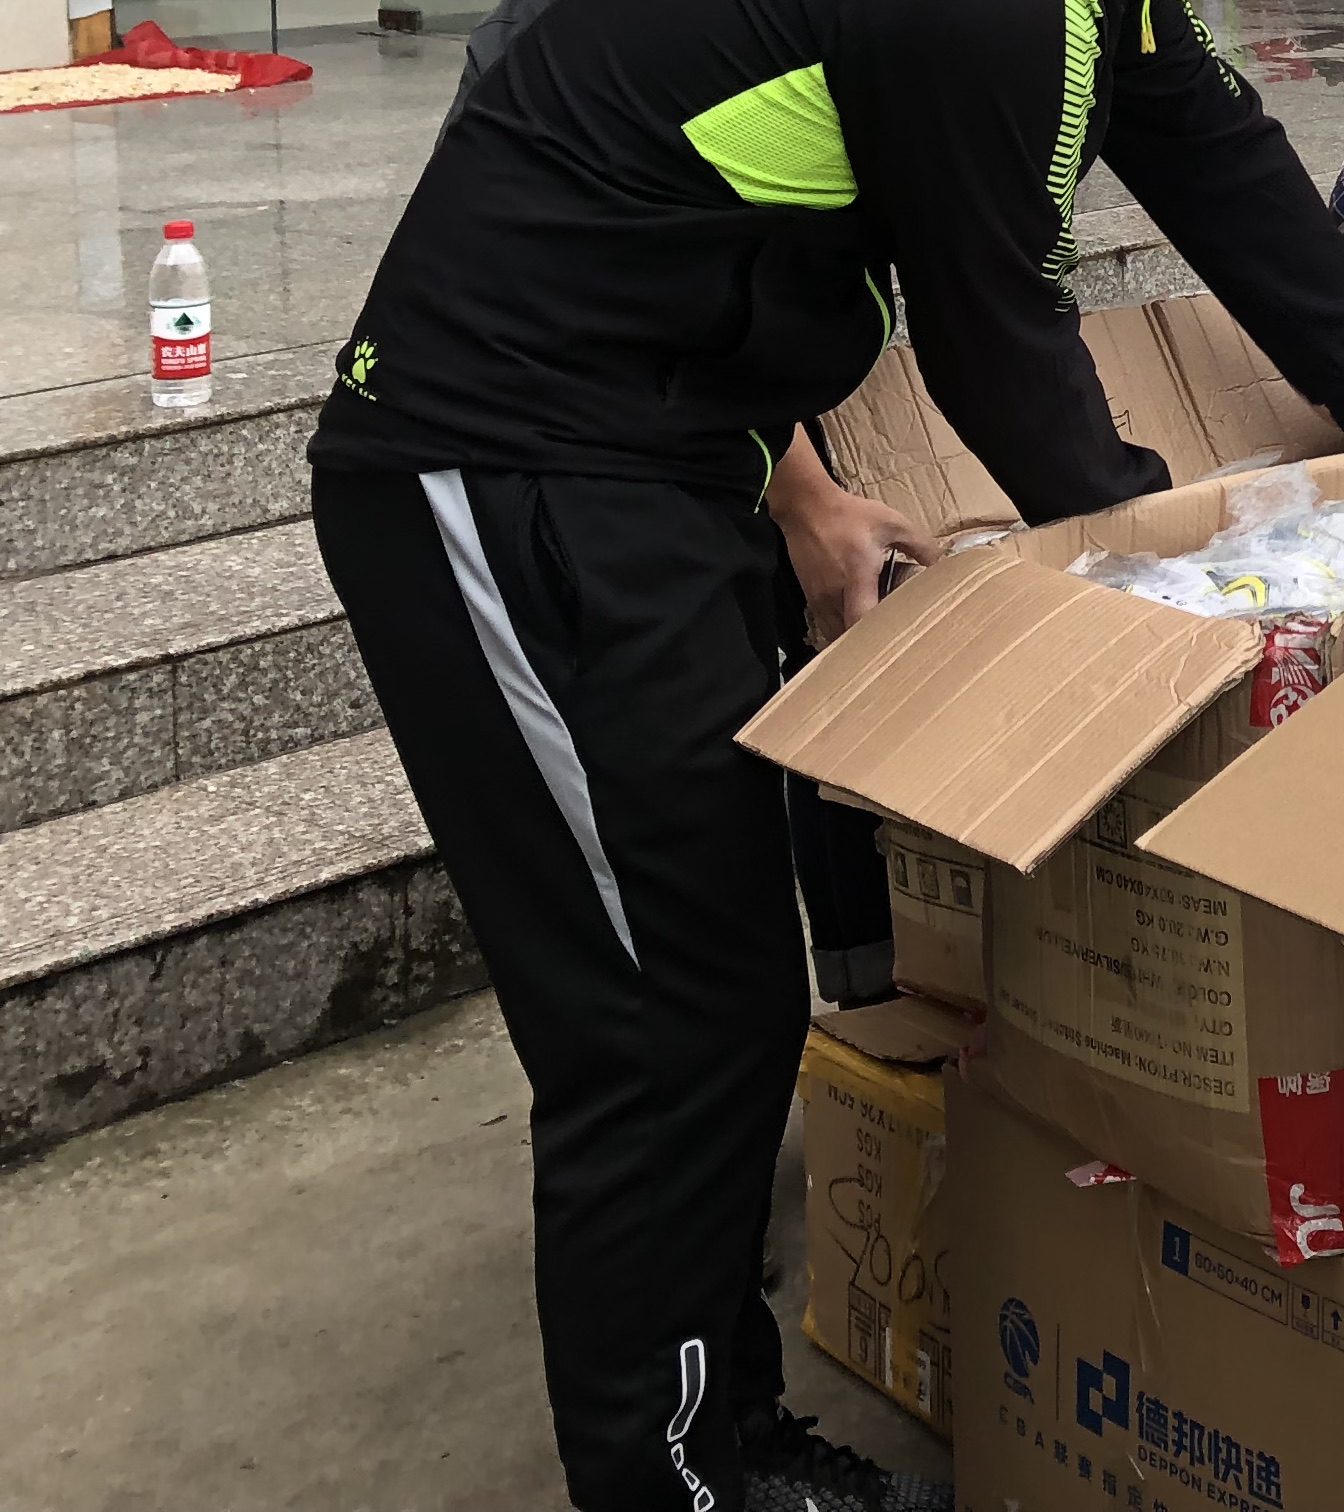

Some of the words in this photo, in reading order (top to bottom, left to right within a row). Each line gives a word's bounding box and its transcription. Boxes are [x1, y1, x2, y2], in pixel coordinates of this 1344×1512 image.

[1095, 866, 1113, 886] CM
[1135, 908, 1155, 928] KG
[1261, 1285, 1283, 1307] CM
[1135, 1390, 1284, 1511] 德邦快递
[1137, 1444, 1203, 1493] DEPPON
